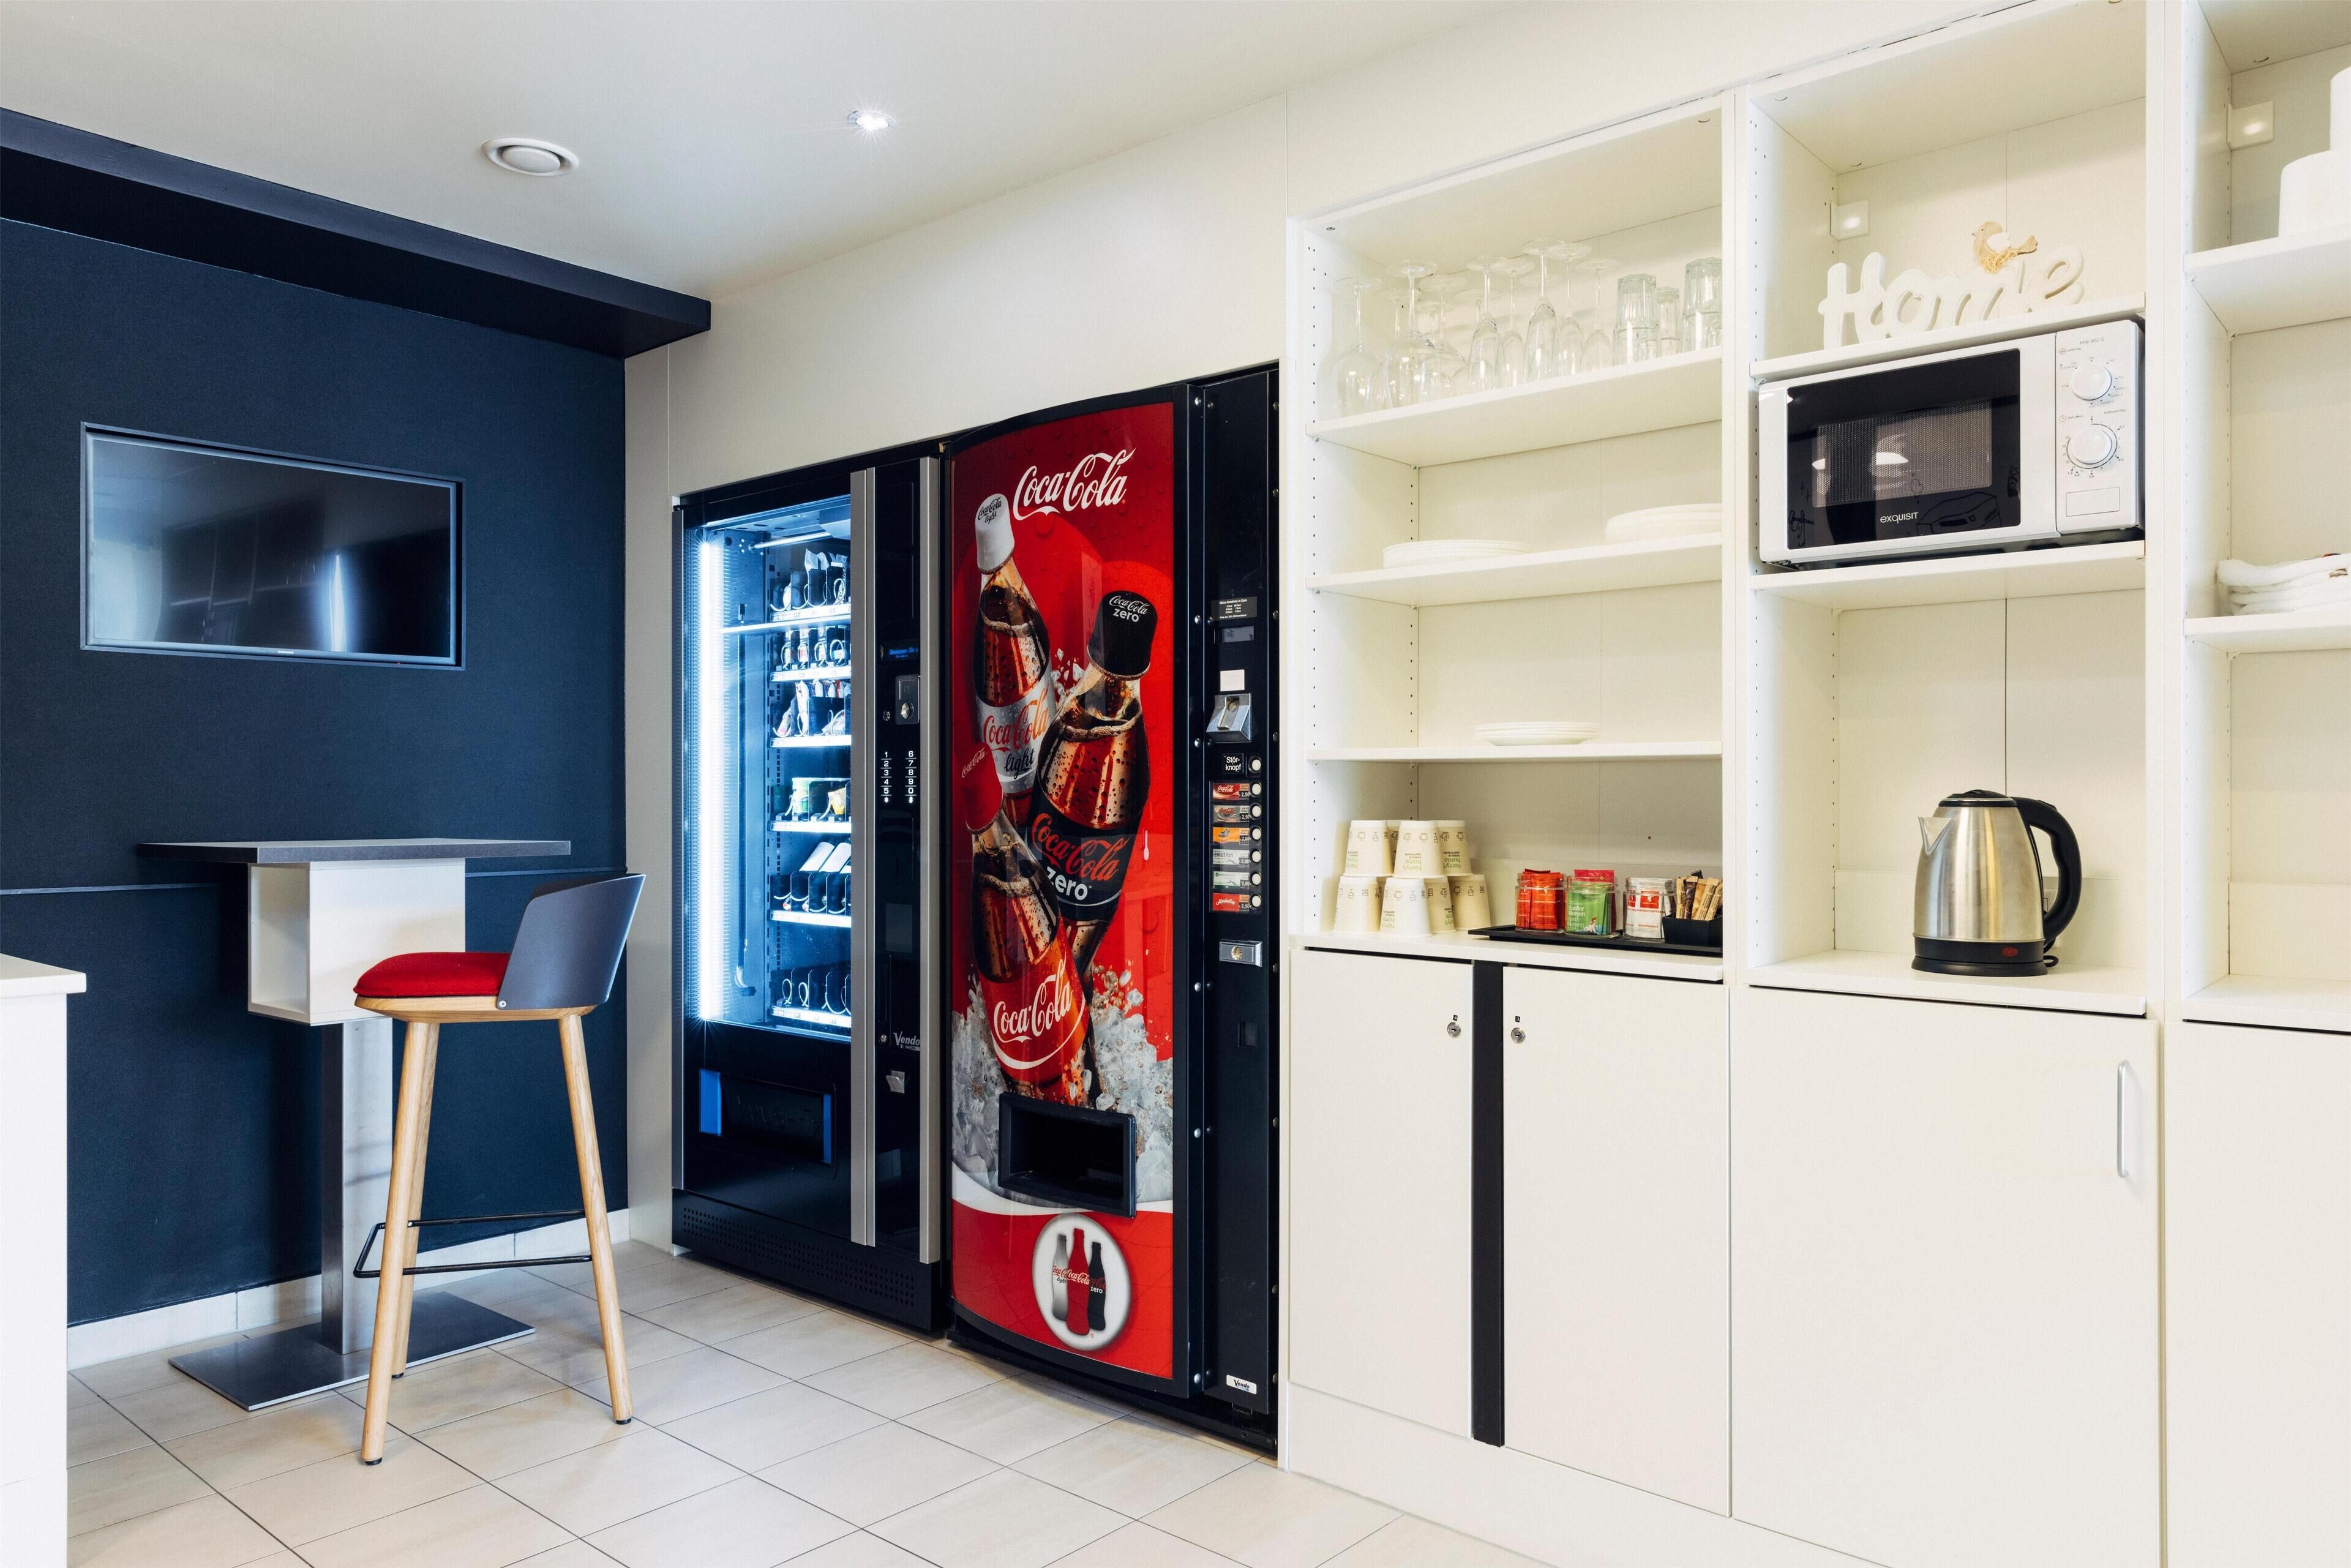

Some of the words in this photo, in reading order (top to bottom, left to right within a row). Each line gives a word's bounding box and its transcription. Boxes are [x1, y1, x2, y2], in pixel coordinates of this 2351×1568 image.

[1818, 247, 2085, 350] Home
[1013, 448, 1136, 520] Coca-Cola
[978, 496, 1002, 520] Coca-Cola
[1109, 595, 1150, 615] Coca-Cola
[1112, 608, 1139, 623] zero
[983, 681, 1049, 752] Coca-Cola
[961, 747, 987, 778] Coca-Cola
[1004, 748, 1035, 779] light
[1225, 763, 1242, 772] knopf
[1032, 813, 1132, 881] Coca-Cola
[1047, 866, 1088, 901] zero
[994, 949, 1073, 1043] Coca-Cola
[893, 1031, 921, 1046] Vendo
[1067, 1269, 1090, 1285] Coca-Cola
[1234, 1379, 1250, 1389] Vendo
